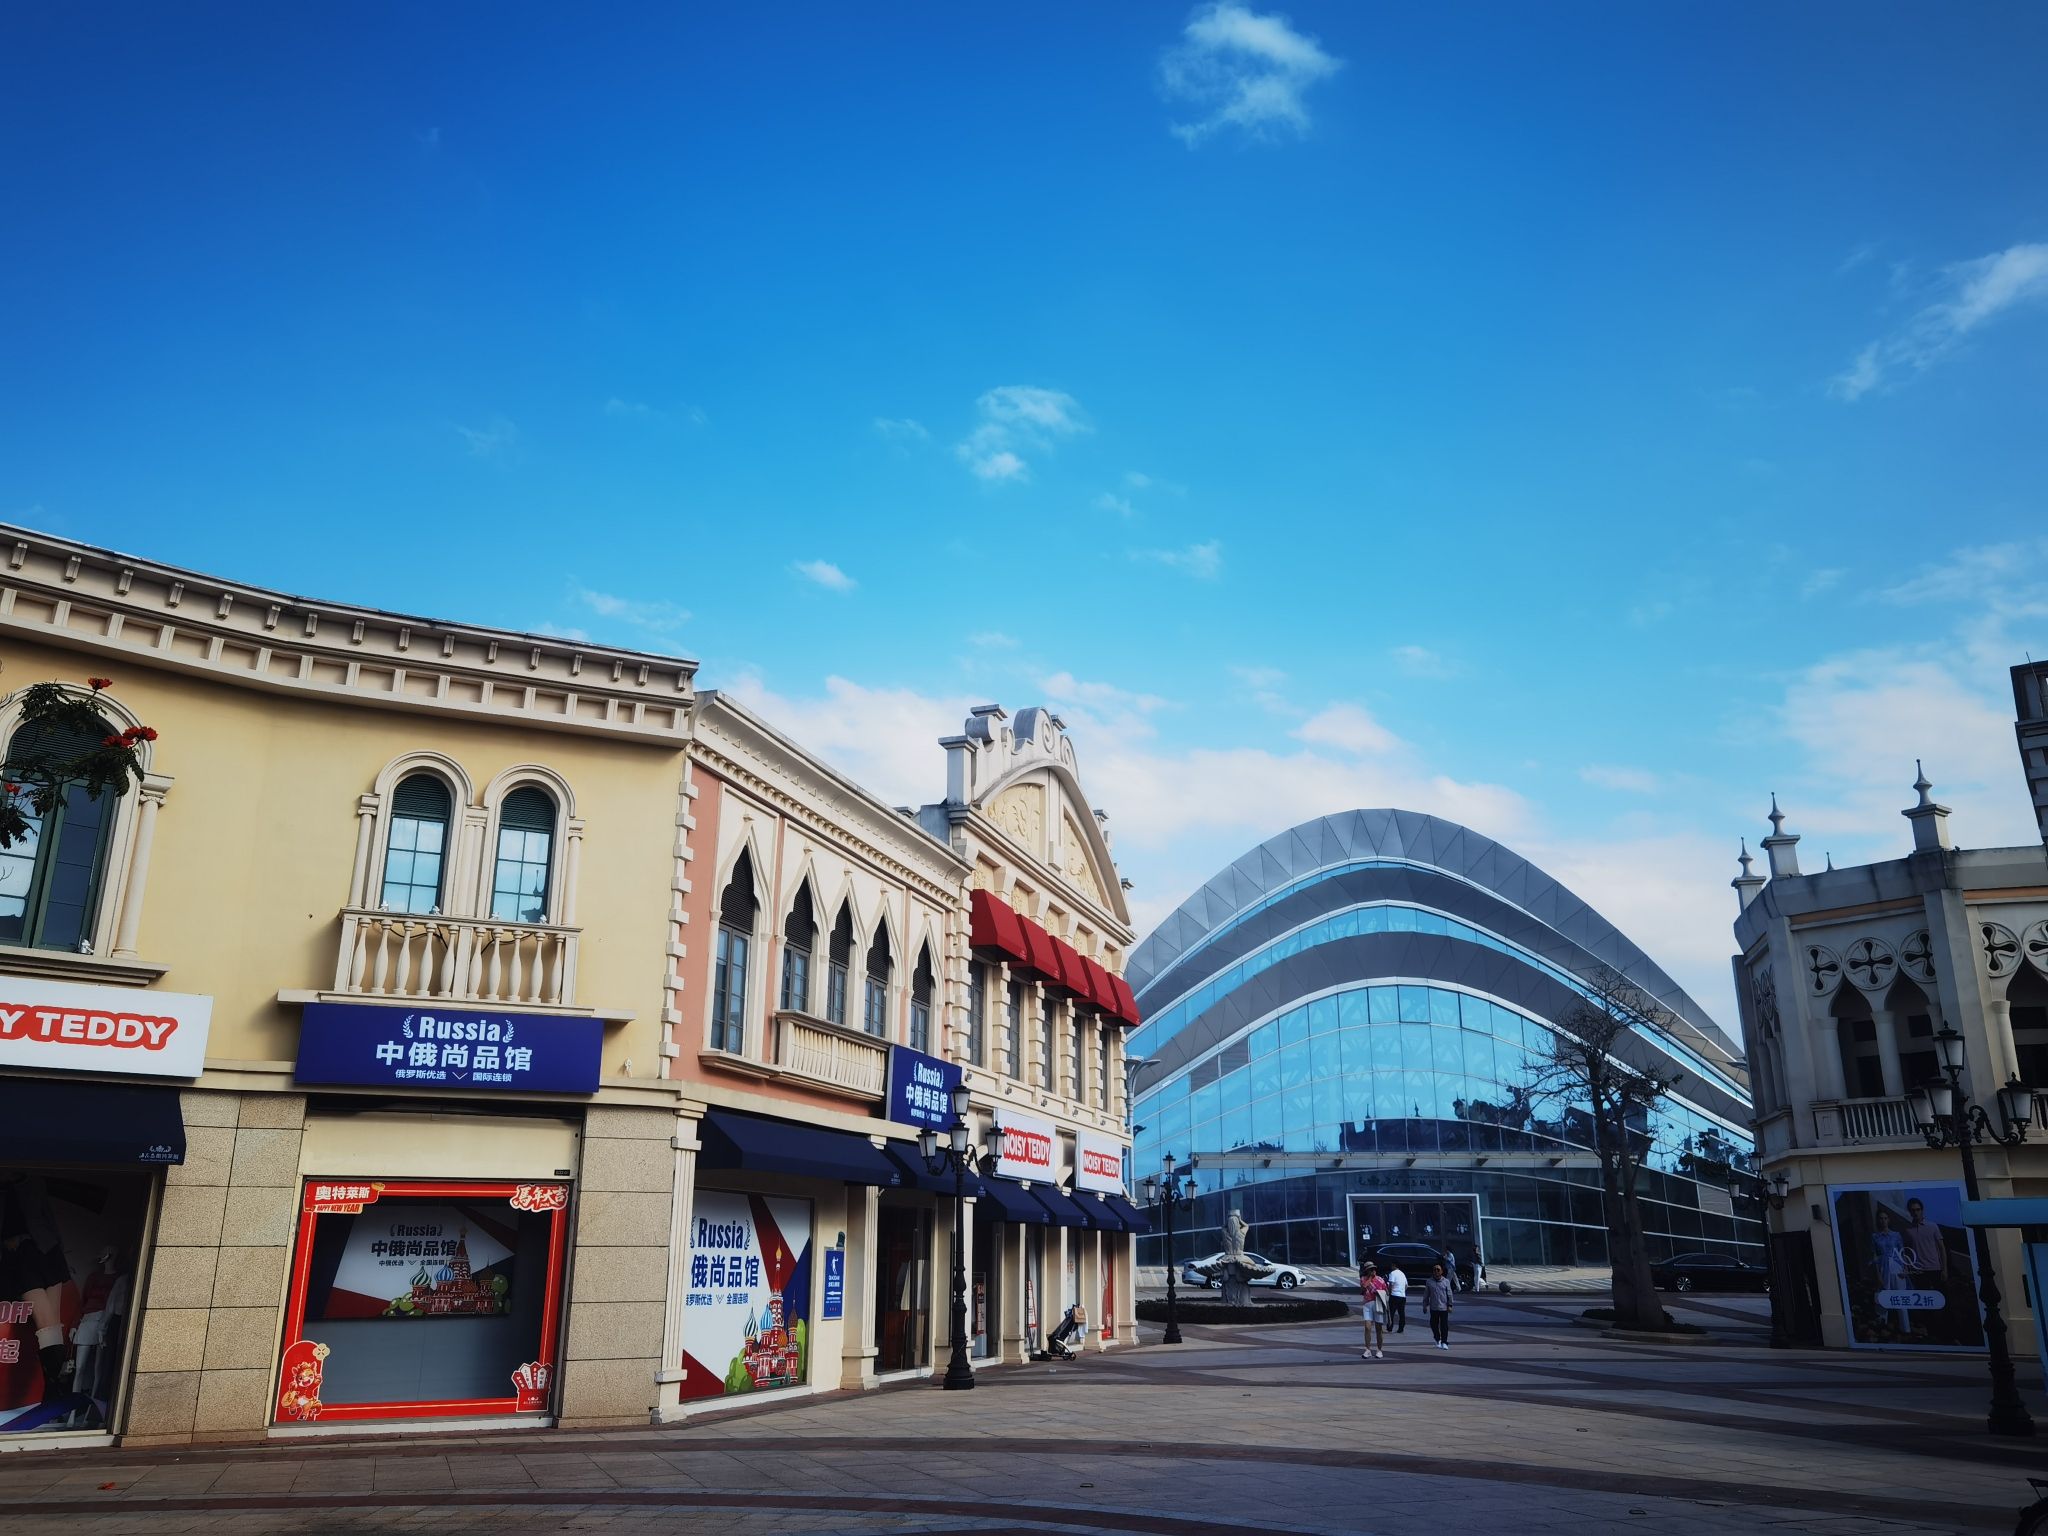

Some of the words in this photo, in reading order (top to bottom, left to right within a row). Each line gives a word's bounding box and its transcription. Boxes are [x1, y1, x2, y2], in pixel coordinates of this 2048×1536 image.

[35, 1012, 170, 1045] TEDDY
[419, 1016, 501, 1042] Russia
[375, 1040, 533, 1072] 中俄尚品馆
[395, 1068, 447, 1080] 俄罗斯优选
[472, 1071, 512, 1083] 国际连锁
[917, 1062, 941, 1087] Russia
[905, 1082, 948, 1114] 中俄尚品馆
[1003, 1133, 1026, 1157] NOISY
[1028, 1137, 1051, 1162] TEDDY
[1083, 1153, 1102, 1172] NOISY
[315, 1185, 371, 1201] 奥特莱斯
[316, 1204, 331, 1212] HAPPY
[331, 1204, 343, 1212] NEW
[343, 1203, 361, 1212] YEAR
[397, 1224, 437, 1237] Russia
[698, 1218, 744, 1249] Russia
[371, 1239, 457, 1257] 中俄尚品馆
[691, 1254, 759, 1289] 俄尚品馆
[1889, 1293, 1934, 1307] 低至2折
